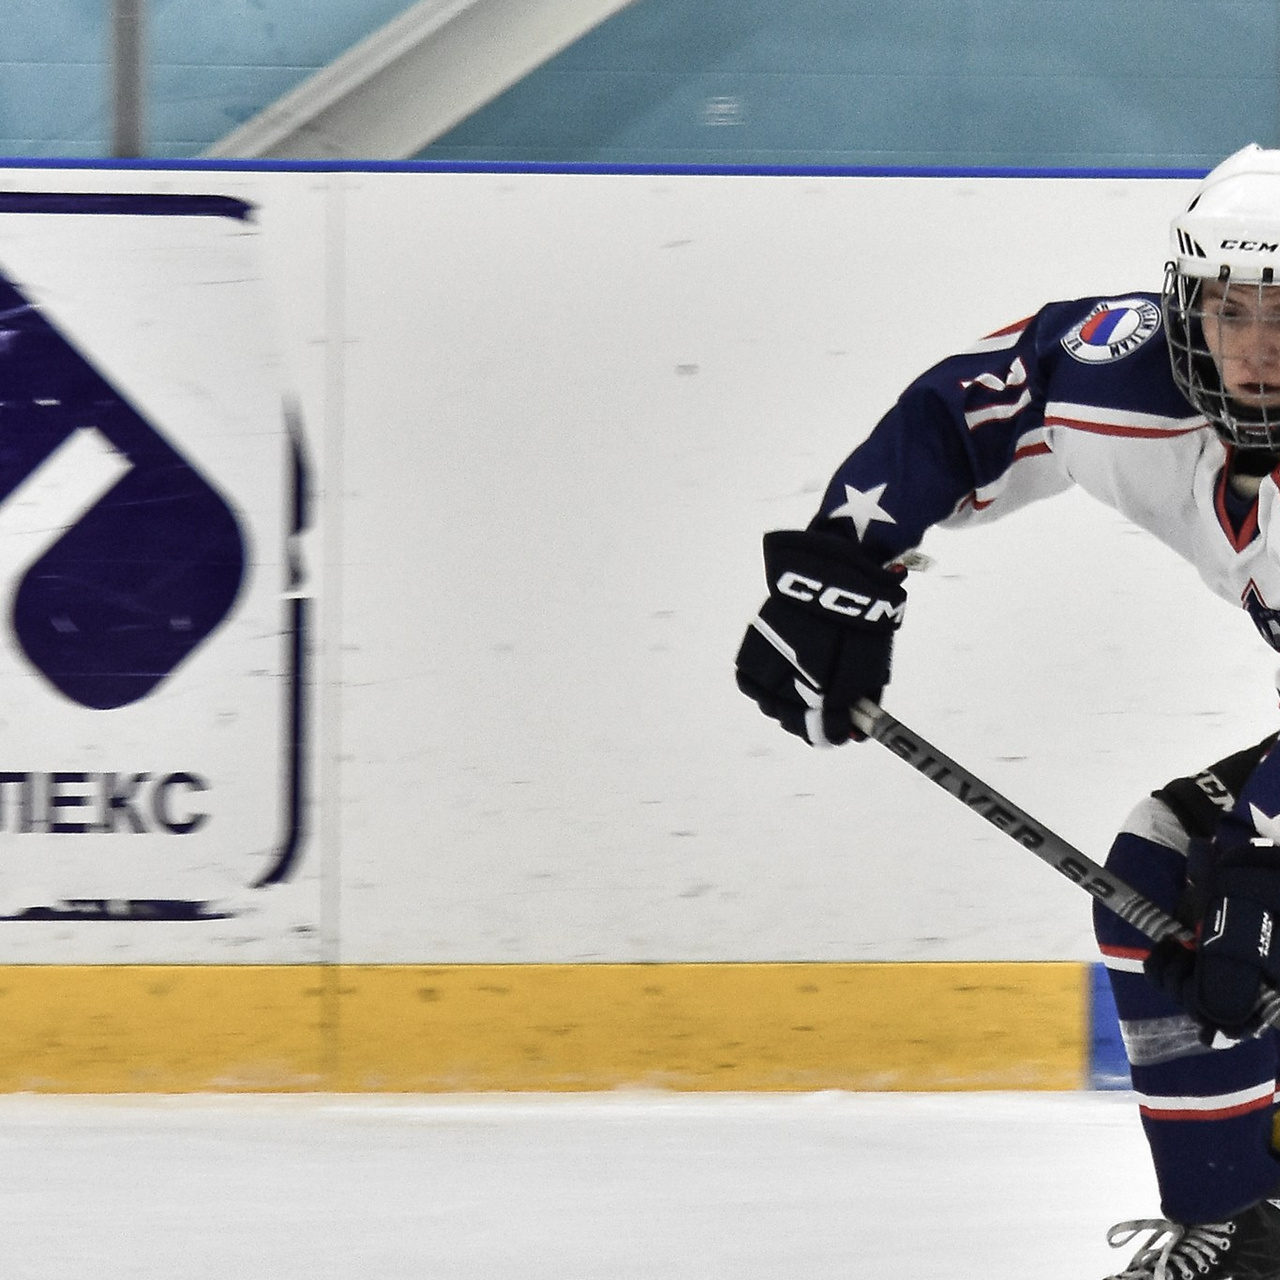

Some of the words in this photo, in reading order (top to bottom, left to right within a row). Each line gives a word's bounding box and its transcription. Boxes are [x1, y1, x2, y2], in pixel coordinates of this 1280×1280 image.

[1220, 240, 1279, 252] CCM
[776, 571, 906, 624] CCM
[886, 733, 1046, 851] SILVER
